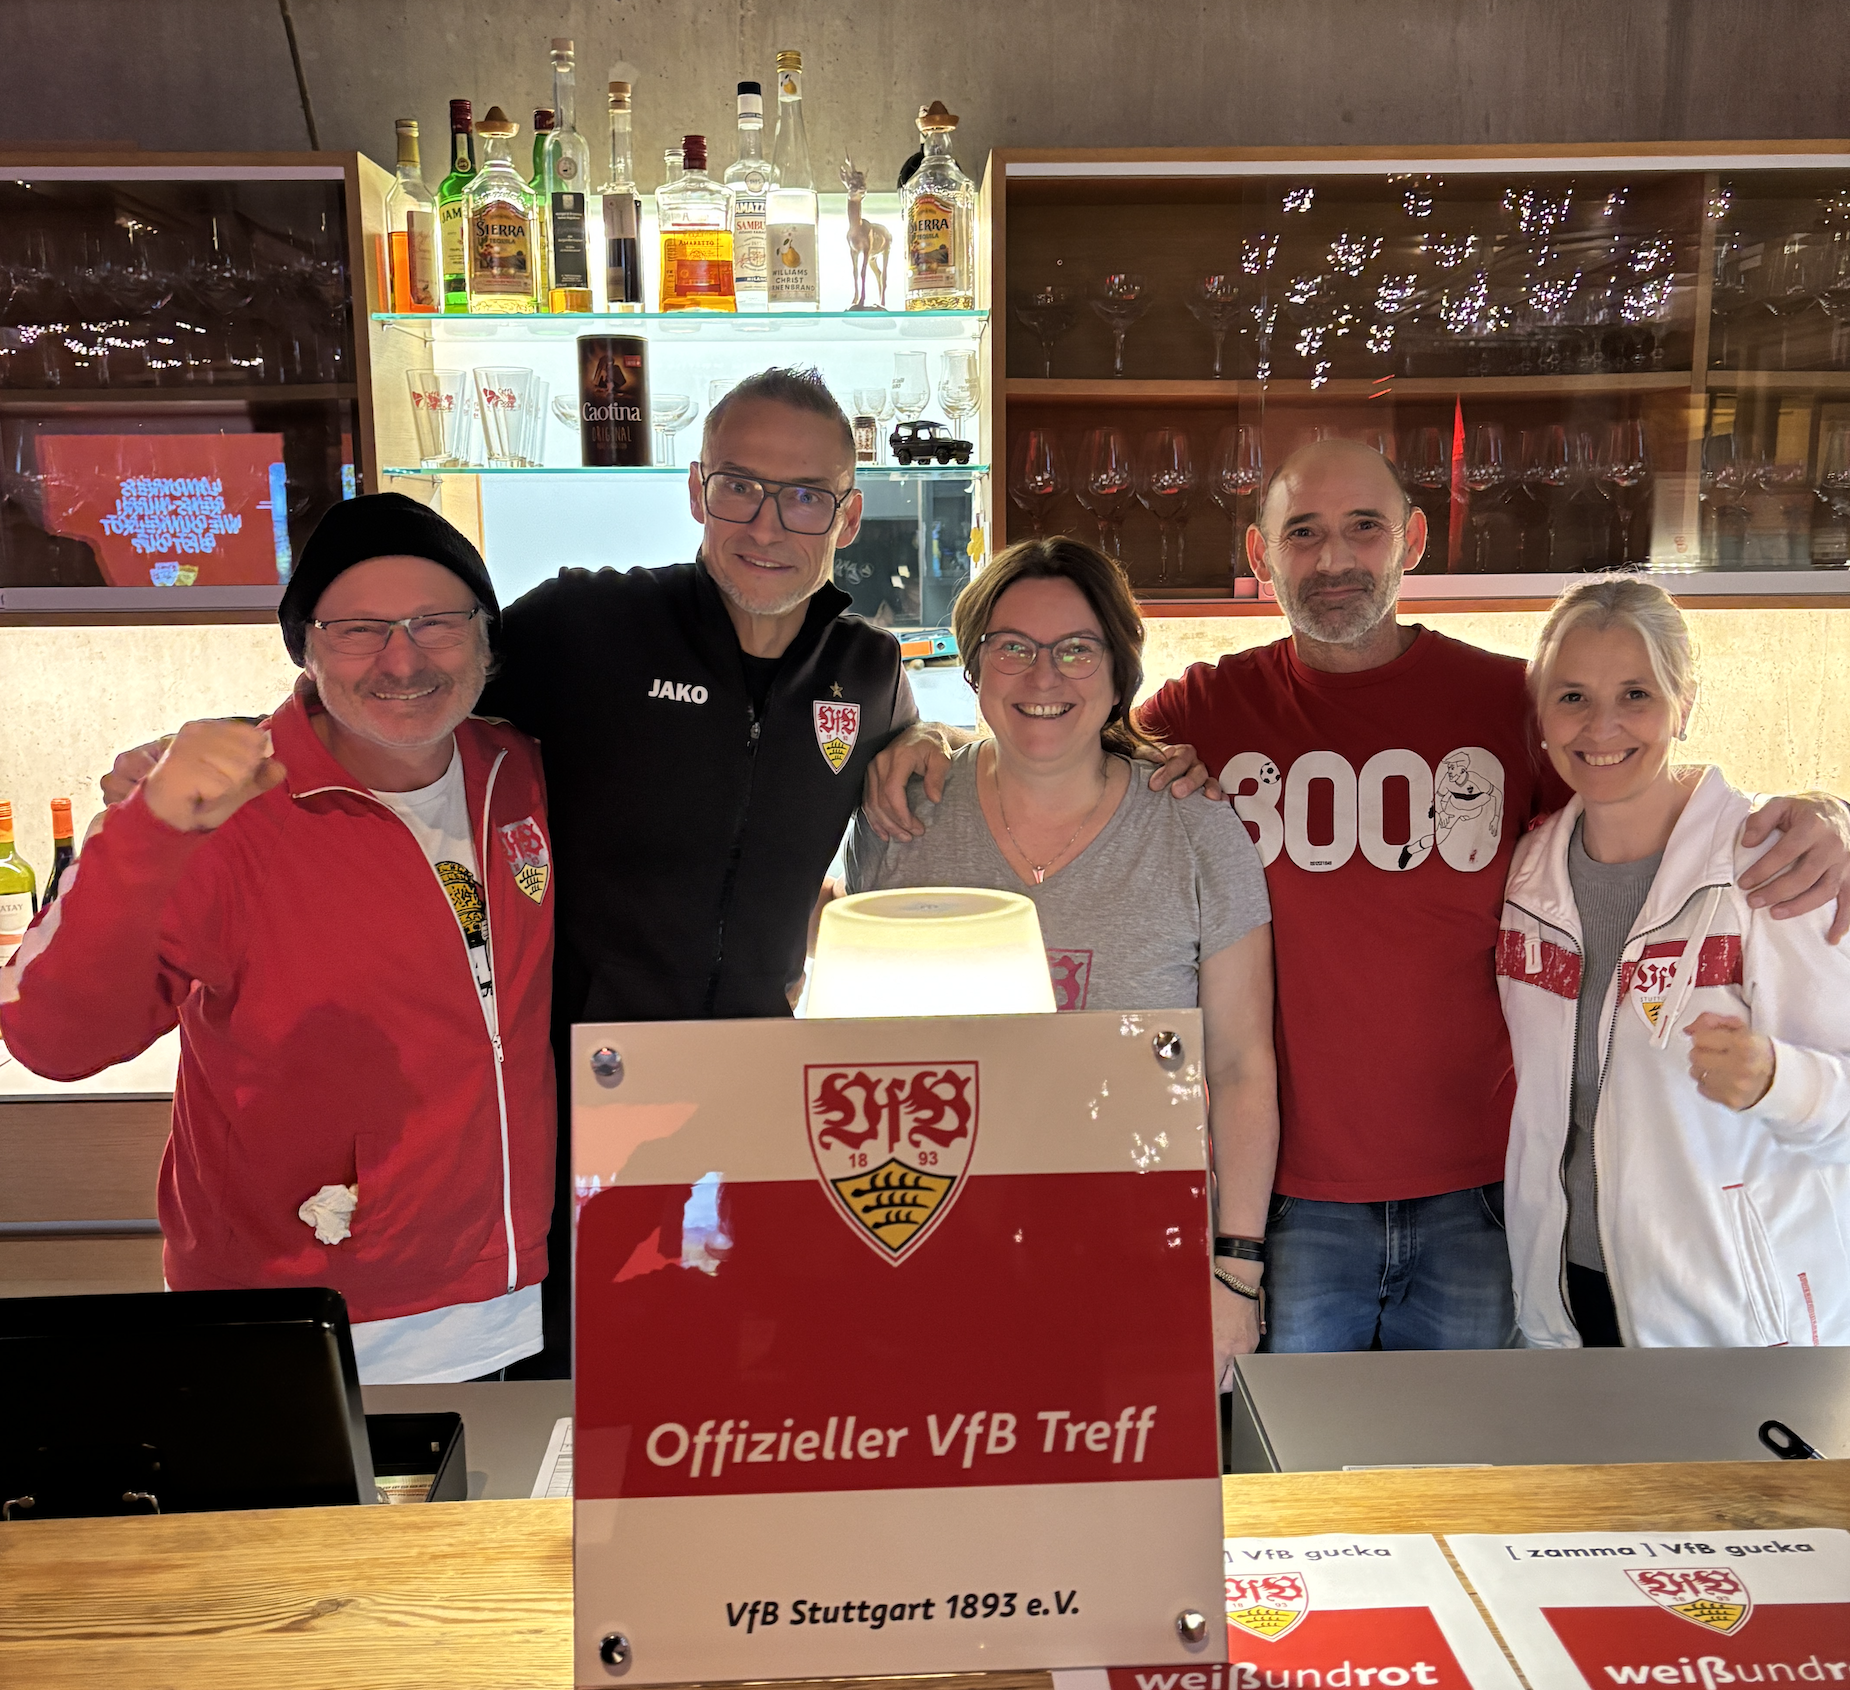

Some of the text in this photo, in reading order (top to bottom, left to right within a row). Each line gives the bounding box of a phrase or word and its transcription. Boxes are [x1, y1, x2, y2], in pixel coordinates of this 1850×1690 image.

[476, 220, 525, 238] SIERRA
[582, 401, 642, 422] Caotina
[591, 425, 632, 442] ORIGNAL
[648, 678, 709, 705] JAKO
[818, 705, 857, 736] VfB
[1218, 746, 1505, 872] 3000
[811, 1069, 972, 1155] VfB
[849, 1151, 938, 1169] 18 93
[646, 1405, 1158, 1478] Offizieller VfB Treff
[1241, 1549, 1294, 1561] VfB
[1304, 1544, 1393, 1561] gucka
[1526, 1545, 1637, 1559] zamma
[1660, 1541, 1717, 1556] VfB
[1724, 1540, 1817, 1558] gucka
[1636, 1569, 1743, 1597] VfB
[726, 1590, 1080, 1634] VfB Stuttgart 1893 e.V.
[1135, 1660, 1439, 1690] weißundrot
[1603, 1655, 1850, 1690] weißundr
